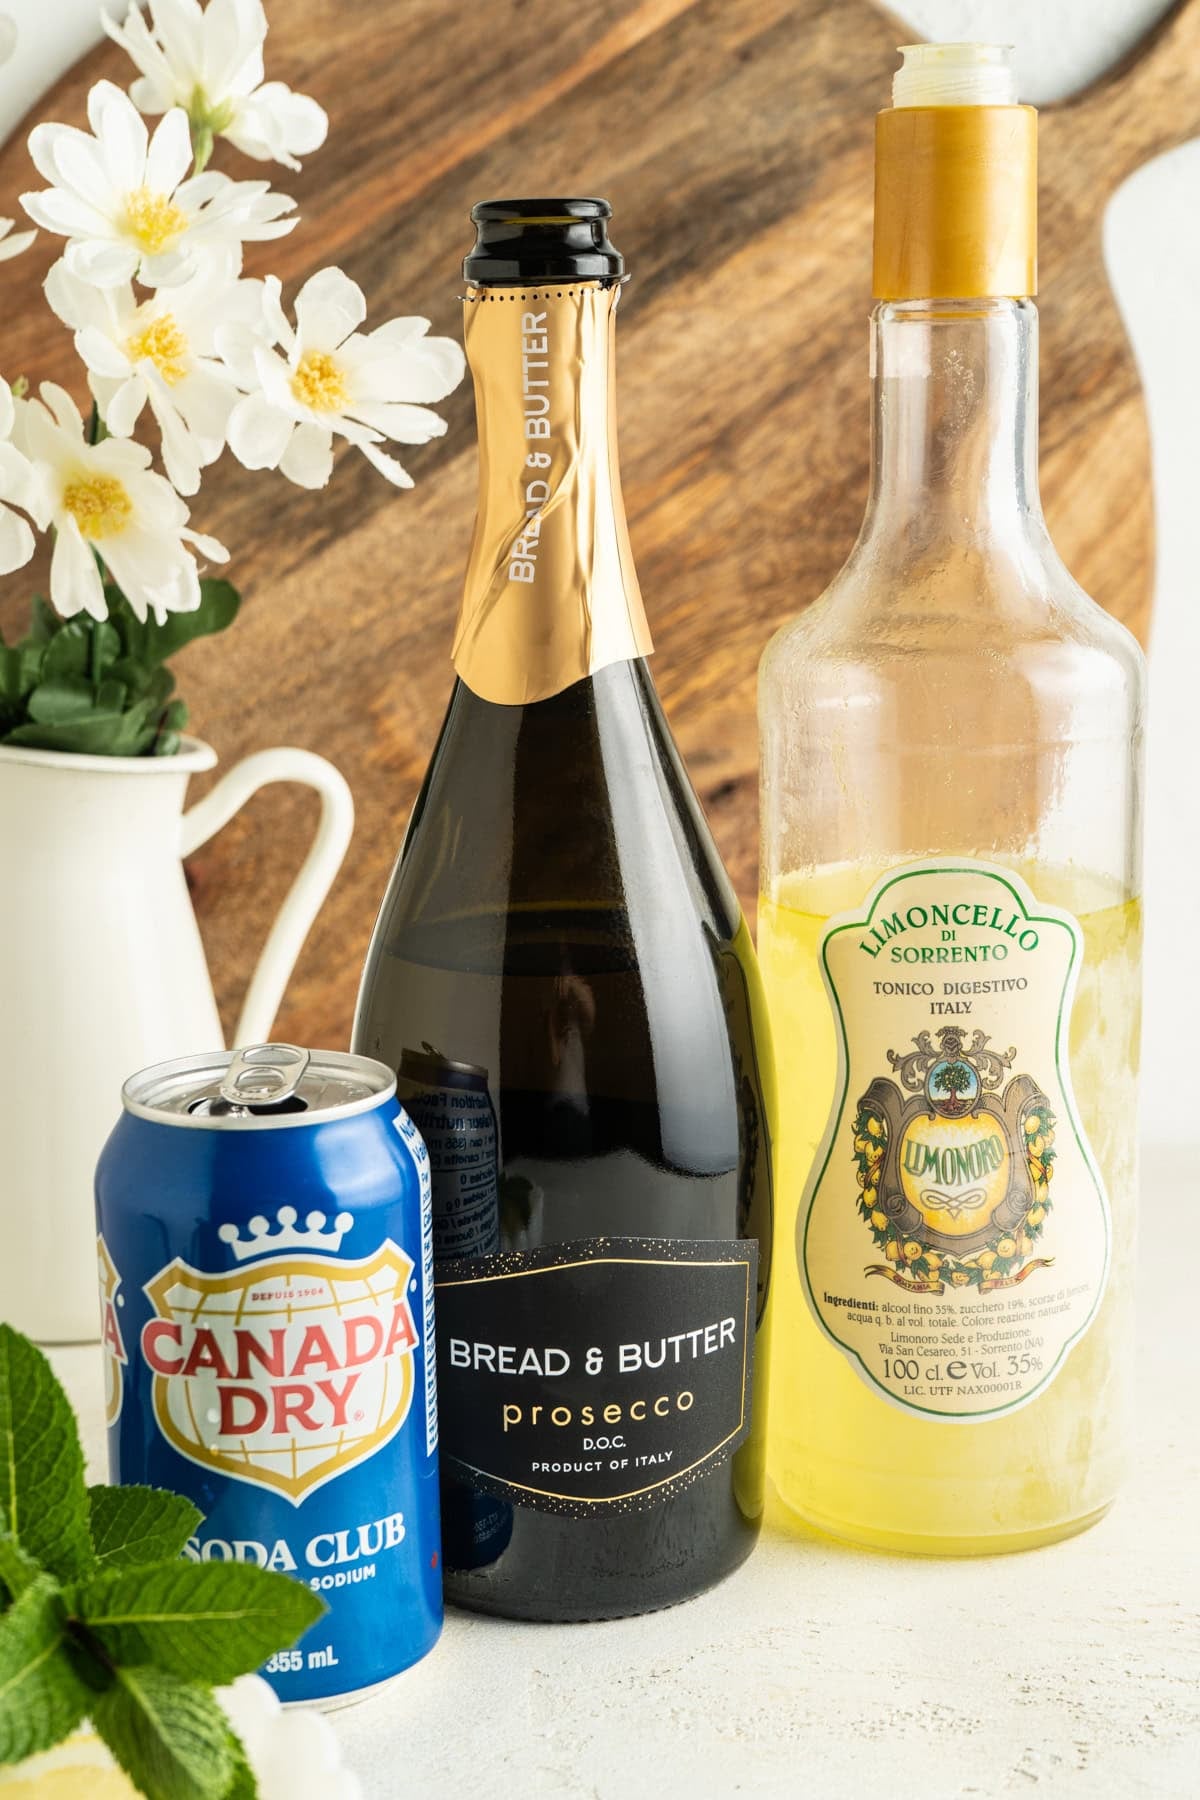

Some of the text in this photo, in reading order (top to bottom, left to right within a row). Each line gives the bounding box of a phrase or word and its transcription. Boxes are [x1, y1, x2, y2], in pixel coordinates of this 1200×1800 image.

[508, 311, 552, 583] BREAD & BUTTER
[859, 903, 1040, 959] LIMONCELLO
[941, 930, 956, 942] DI
[890, 944, 1009, 964] SORRENTO
[873, 977, 1028, 996] TONICO DIGESTIVO
[930, 1001, 973, 1015] ITALY
[904, 1134, 1004, 1187] LIMONORO
[252, 1289, 295, 1301] DEPUIS
[823, 1292, 879, 1311] Ingredienti:
[881, 1303, 911, 1314] alcool
[914, 1304, 933, 1314] fino
[960, 1302, 1005, 1313] zucchero
[847, 1311, 873, 1325] acqua
[897, 1315, 906, 1325] al
[961, 1315, 994, 1327] Colore
[997, 1310, 1035, 1324] reazione
[1038, 1302, 1072, 1317] naturale
[141, 1302, 416, 1379] CANADA
[449, 1317, 736, 1376] BREAD & BUTTER
[879, 1343, 893, 1355] Via
[896, 1344, 914, 1356] San
[961, 1346, 971, 1357] 51
[981, 1342, 1022, 1355] Sorrento
[1025, 1336, 1045, 1349] (NA)
[891, 1332, 939, 1344] Limonoro
[941, 1333, 965, 1344] Sede
[884, 1359, 920, 1380] 100
[925, 1365, 944, 1381] cl.
[970, 1361, 1001, 1379] Vol.
[1007, 1354, 1044, 1376] 35%
[904, 1386, 926, 1395] LIC.
[930, 1386, 954, 1396] UTF
[218, 1372, 361, 1436] DRY
[503, 1391, 694, 1431] prosecco
[583, 1436, 627, 1450] D.O.C.
[532, 1451, 674, 1473] PRODUCT OF ITALY
[179, 1512, 406, 1572] SODA CLUB
[310, 1563, 376, 1592] SODIUM
[265, 1646, 339, 1674] 355 mL
